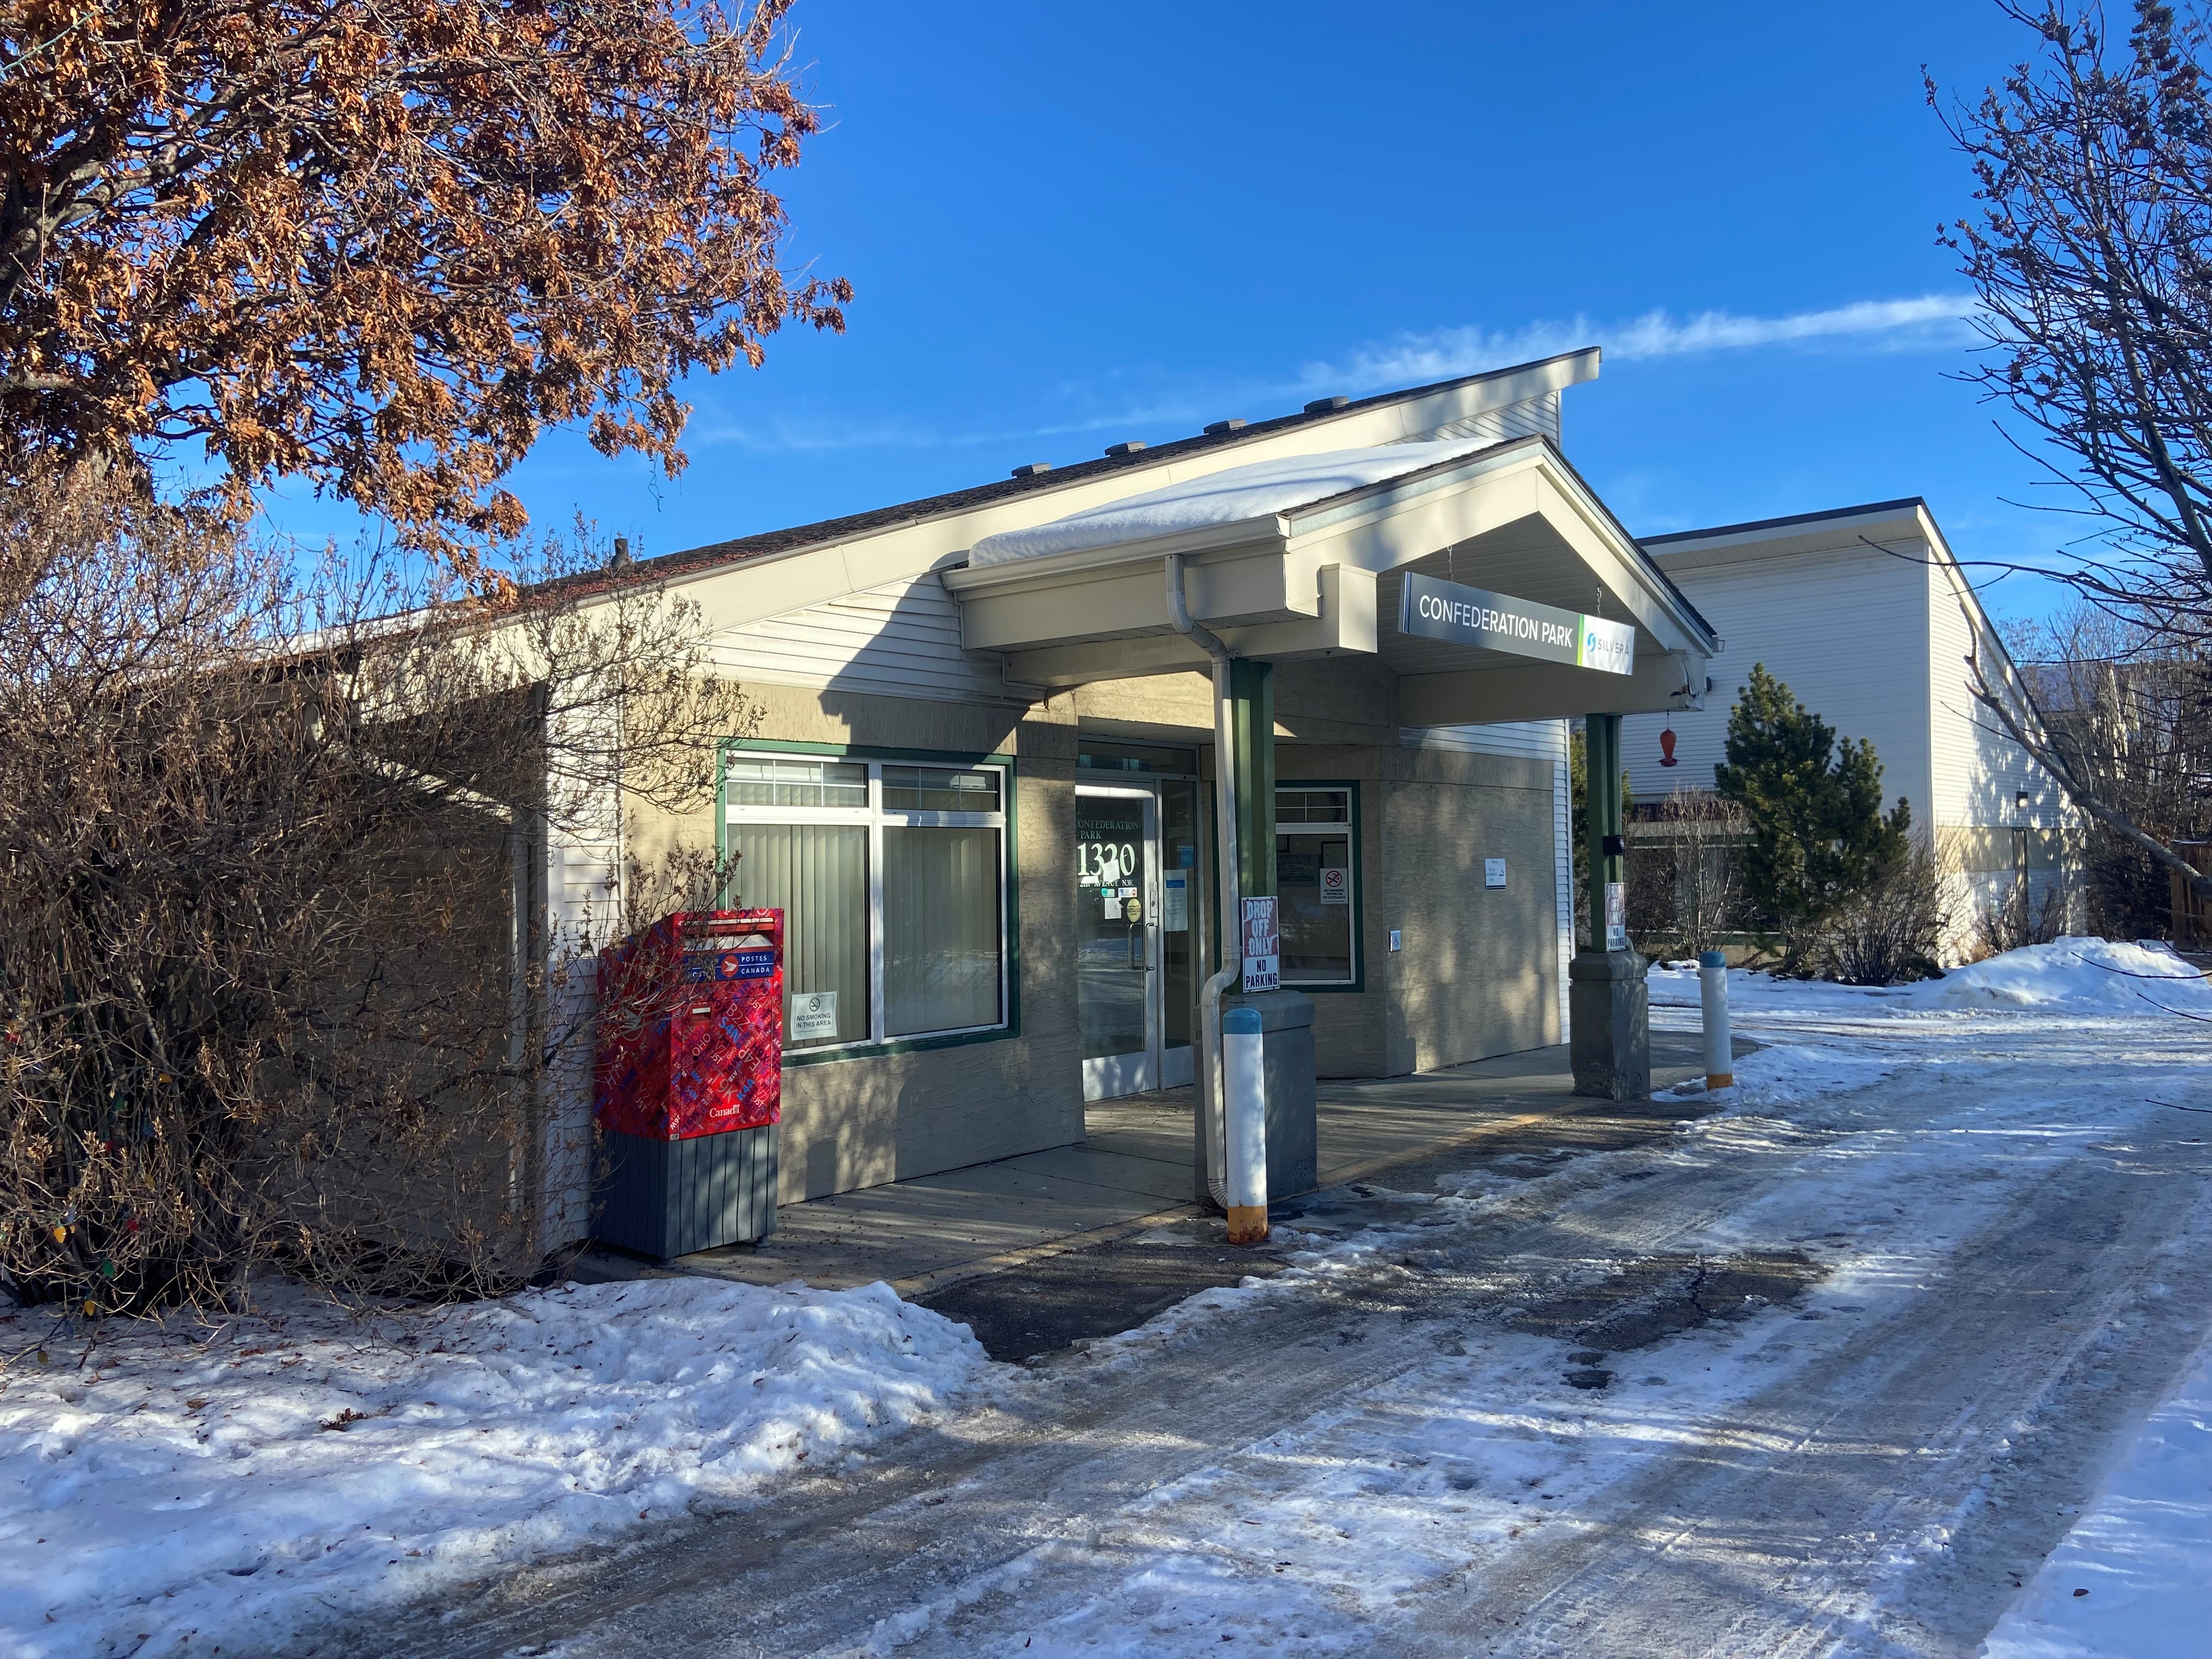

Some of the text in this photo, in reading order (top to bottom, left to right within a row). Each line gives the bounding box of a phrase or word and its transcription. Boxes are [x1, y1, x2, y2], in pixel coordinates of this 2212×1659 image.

[1419, 595, 1574, 648] CONFEDERATION PARK
[1598, 639, 1629, 656] SILVERA
[1080, 830, 1102, 839] PARK
[1077, 843, 1135, 876] 1320
[1245, 900, 1273, 920] DROP
[1251, 918, 1269, 938] OFF
[1248, 935, 1275, 956] ONLY
[1256, 959, 1266, 973] NO
[1245, 973, 1278, 988] PARKING
[726, 1003, 751, 1032] B2Z
[736, 1078, 756, 1102] K4A
[709, 1104, 740, 1118] Canada
